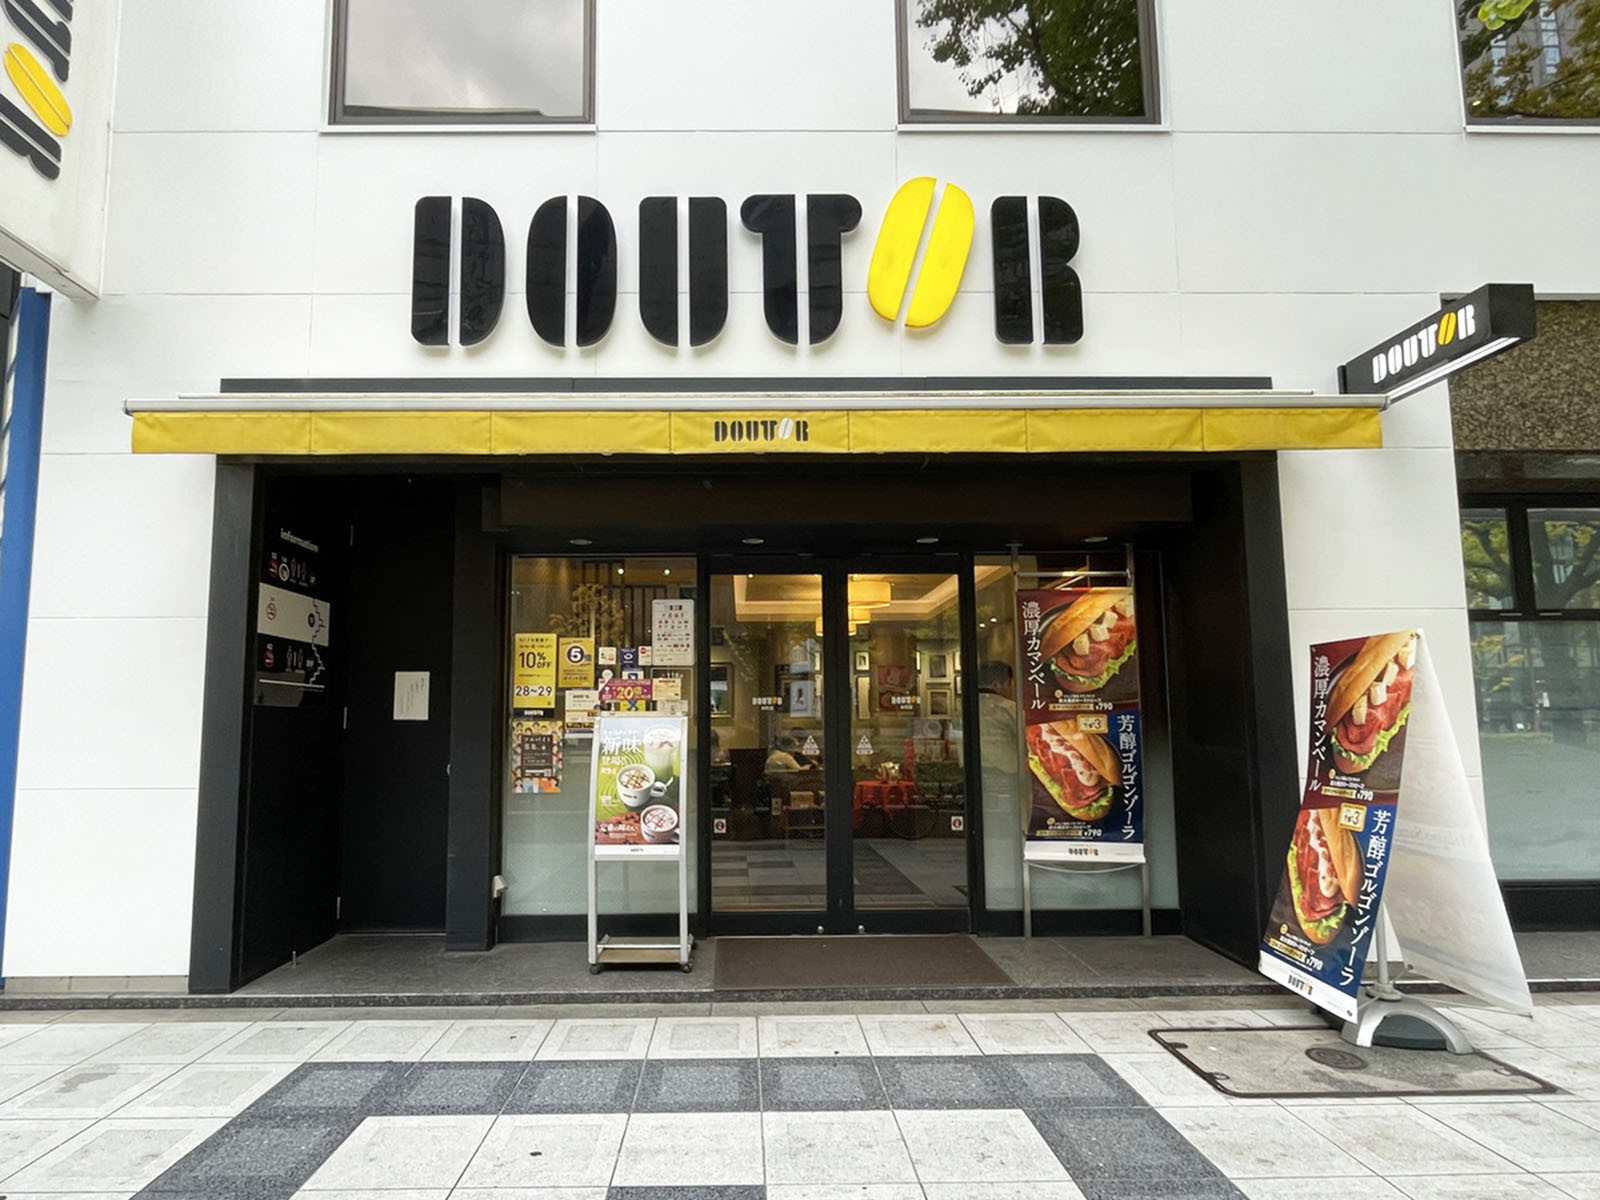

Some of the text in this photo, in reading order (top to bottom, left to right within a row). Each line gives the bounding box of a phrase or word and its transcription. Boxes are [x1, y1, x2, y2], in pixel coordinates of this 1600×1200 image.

[411, 176, 1084, 347] DOUTOR
[1372, 304, 1476, 384] DOUTOR
[714, 417, 808, 442] DOUTOR
[1022, 601, 1046, 710] 濃厚カマンベール
[1117, 714, 1139, 840] 芳醇ゴルゴンゾーラ
[1308, 655, 1330, 791] 濃厚カマンベール
[1339, 810, 1392, 986] 芳醇ゴルゴンゾーラ
